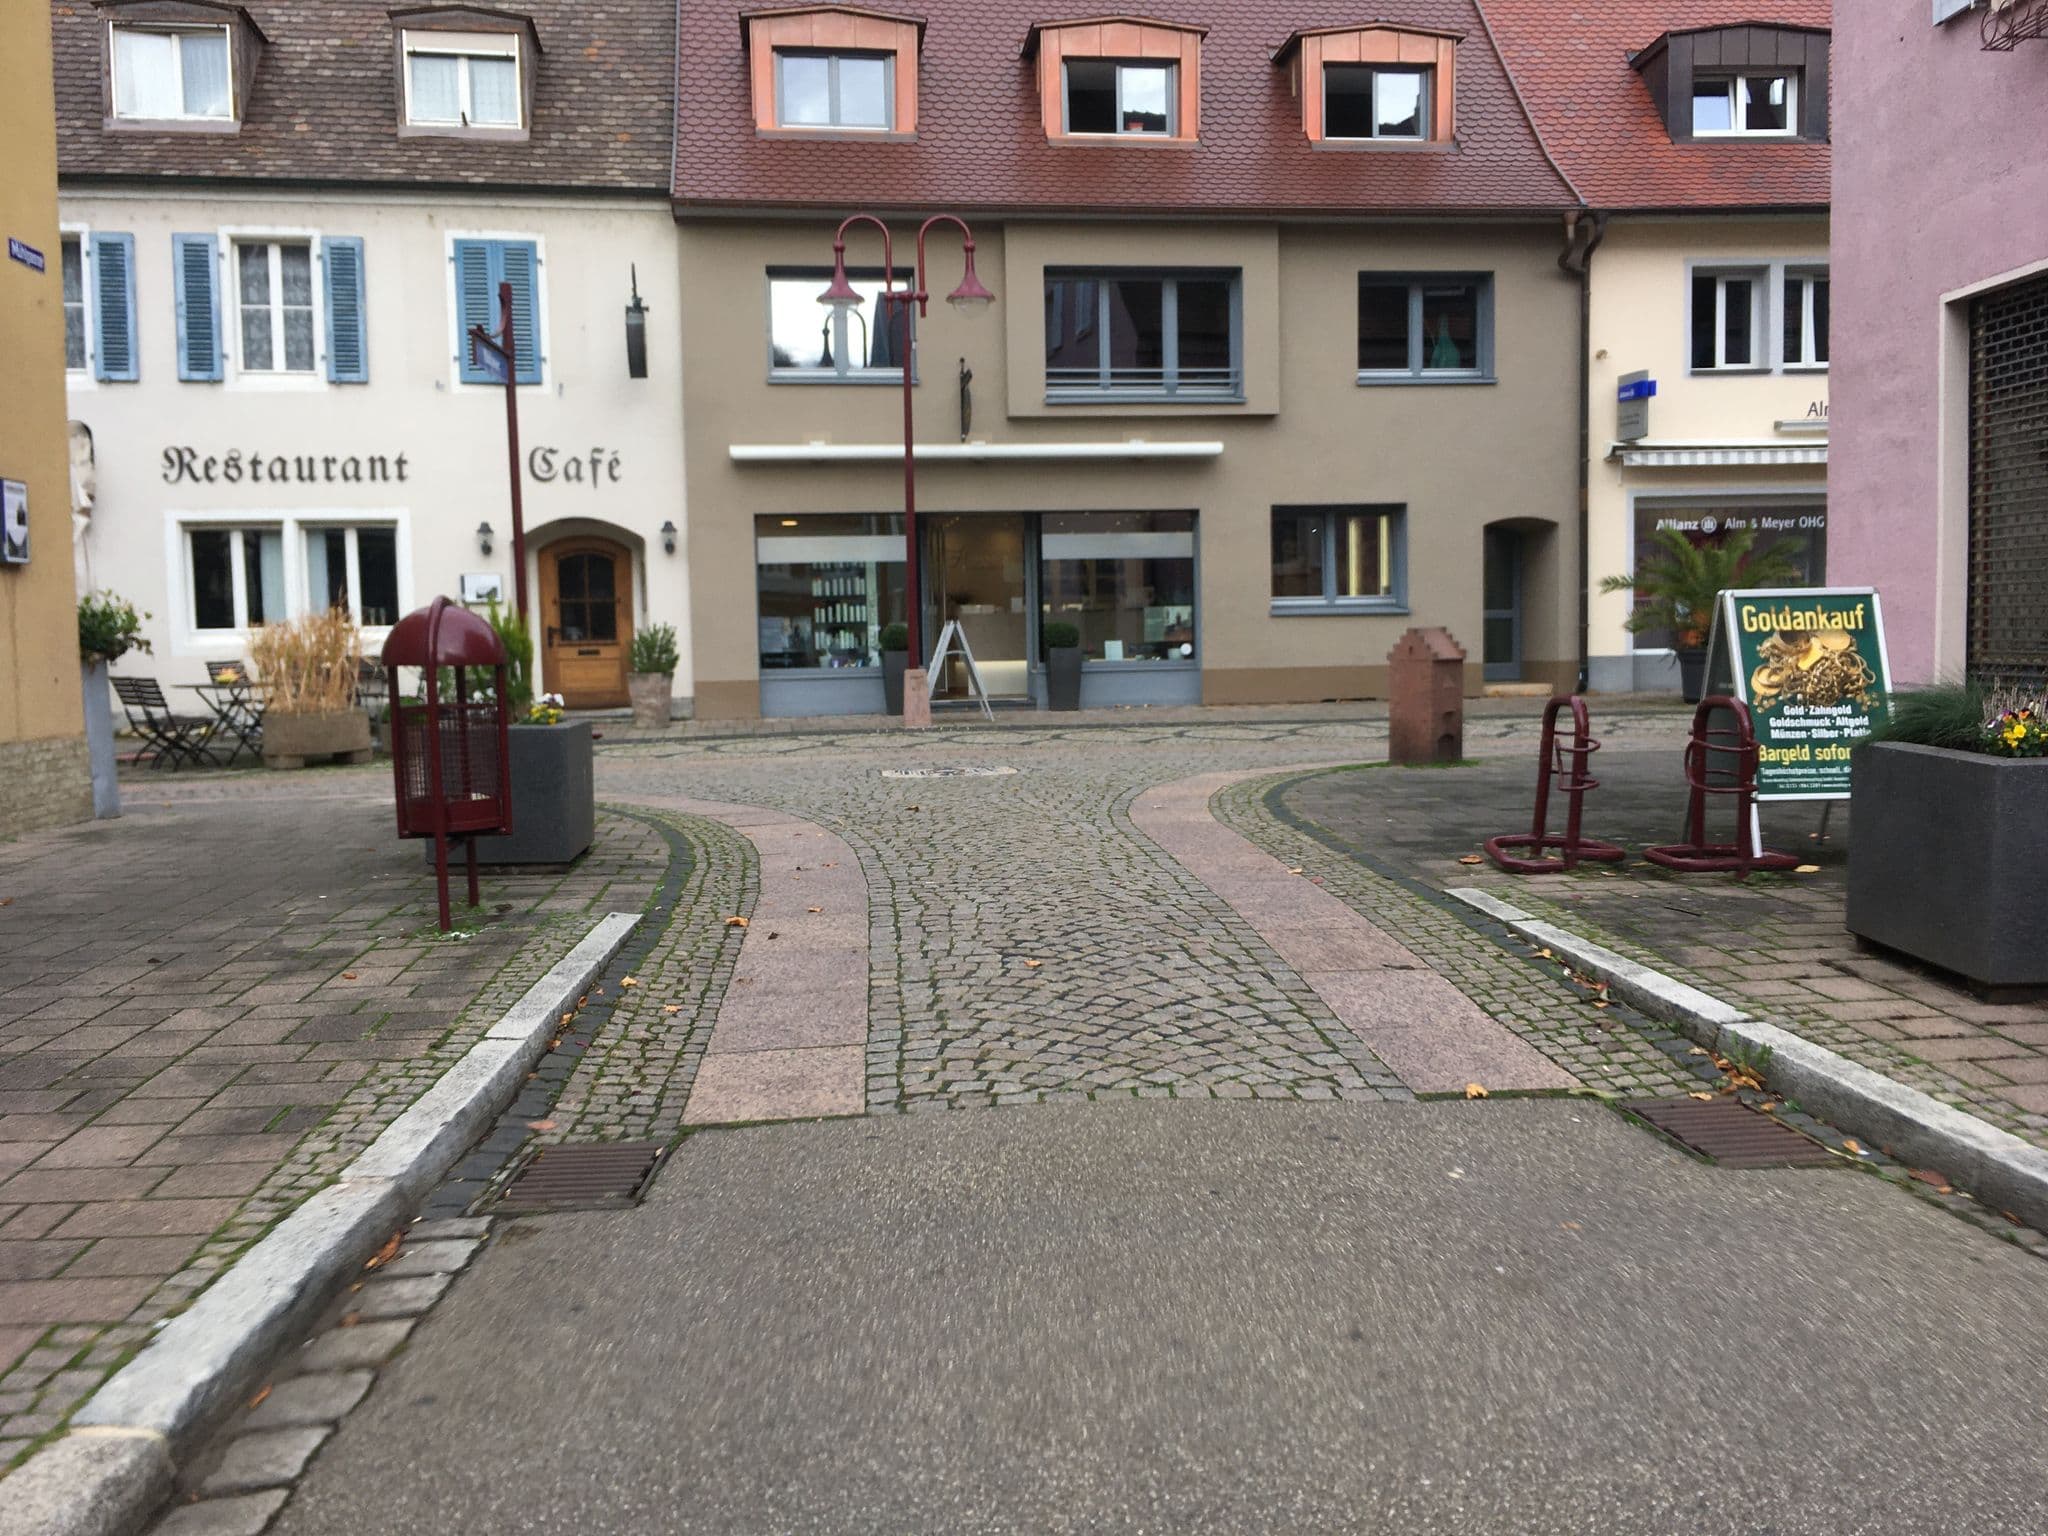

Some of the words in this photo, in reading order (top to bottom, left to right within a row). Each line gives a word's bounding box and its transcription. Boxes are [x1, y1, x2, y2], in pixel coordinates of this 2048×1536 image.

[161, 446, 410, 484] Restaurant
[528, 446, 622, 488] Café
[1656, 518, 1699, 531] Allianz
[1725, 518, 1746, 530] Alm
[1761, 517, 1795, 531] Meyer
[1799, 516, 1825, 529] OHG
[1742, 603, 1864, 632] Goldankauf
[1783, 705, 1805, 716] Gold
[1808, 704, 1852, 717] Zahngold
[1768, 716, 1832, 728] Goldschmuck
[1835, 715, 1869, 728] Altgold
[1770, 728, 1807, 739] Münzen
[1811, 727, 1839, 739] Silber
[1759, 744, 1811, 766] Bargeld
[1814, 743, 1852, 760] sofor
